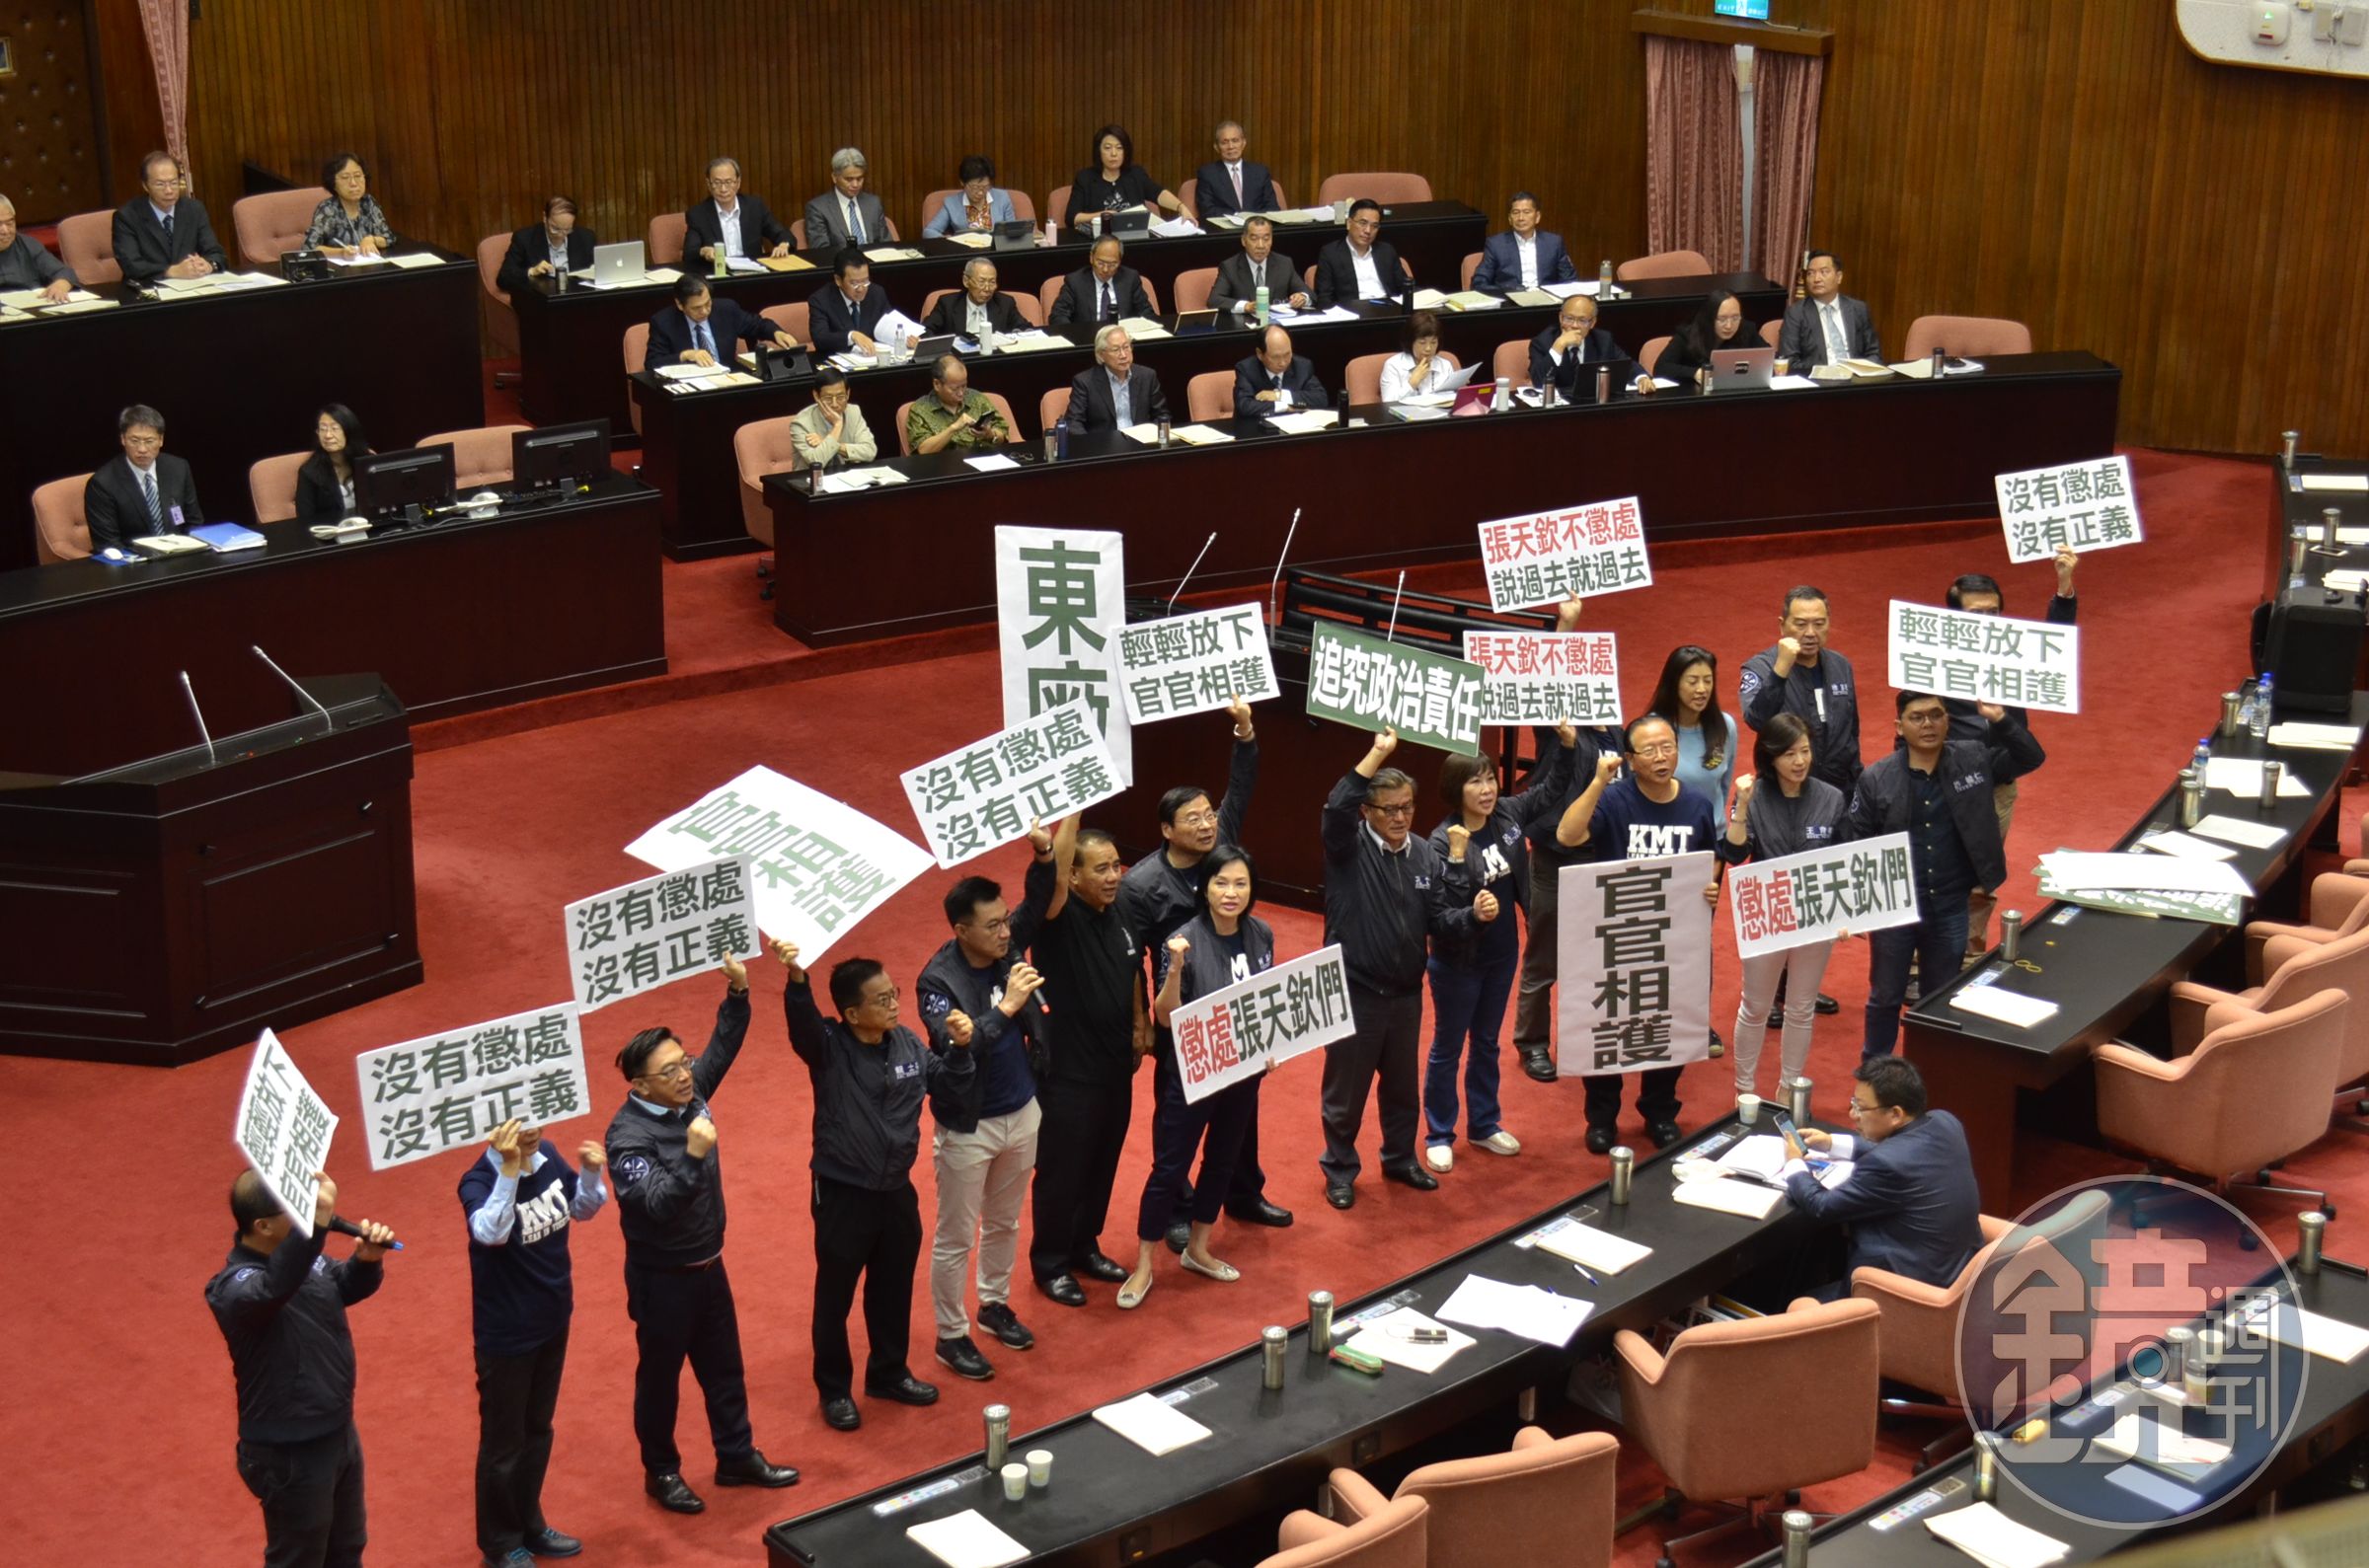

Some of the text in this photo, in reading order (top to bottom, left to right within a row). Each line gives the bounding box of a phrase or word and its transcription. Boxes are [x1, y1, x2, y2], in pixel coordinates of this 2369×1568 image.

[1484, 502, 1641, 564] 張天欽不懲處
[2005, 463, 2125, 514] 沒有懲處
[2012, 505, 2133, 557] 沒有正義
[1119, 611, 1254, 670] 輕輕放下
[1469, 635, 1614, 676] 張天欽不懲處
[1898, 608, 2065, 663] 輕輕放下
[1899, 652, 2067, 707] 官官相護
[1129, 655, 1269, 716] 官官相護
[1311, 635, 1481, 743] 追究政治責任
[915, 709, 1093, 813] 沒有懲處
[937, 755, 1112, 859] 沒有正義
[1627, 824, 1693, 855] KMT
[576, 860, 744, 950] 沒有懲處
[667, 790, 897, 933] 官官相護
[1735, 847, 1911, 941] 懲處張天欽們
[582, 913, 750, 1005] 沒有正義
[1591, 865, 1672, 1070] 官官相護
[371, 1012, 573, 1103] 沒有懲處
[1178, 960, 1348, 1084] 懲處張天欽們
[379, 1068, 578, 1159] 沒有正義
[516, 1178, 569, 1235] KMT
